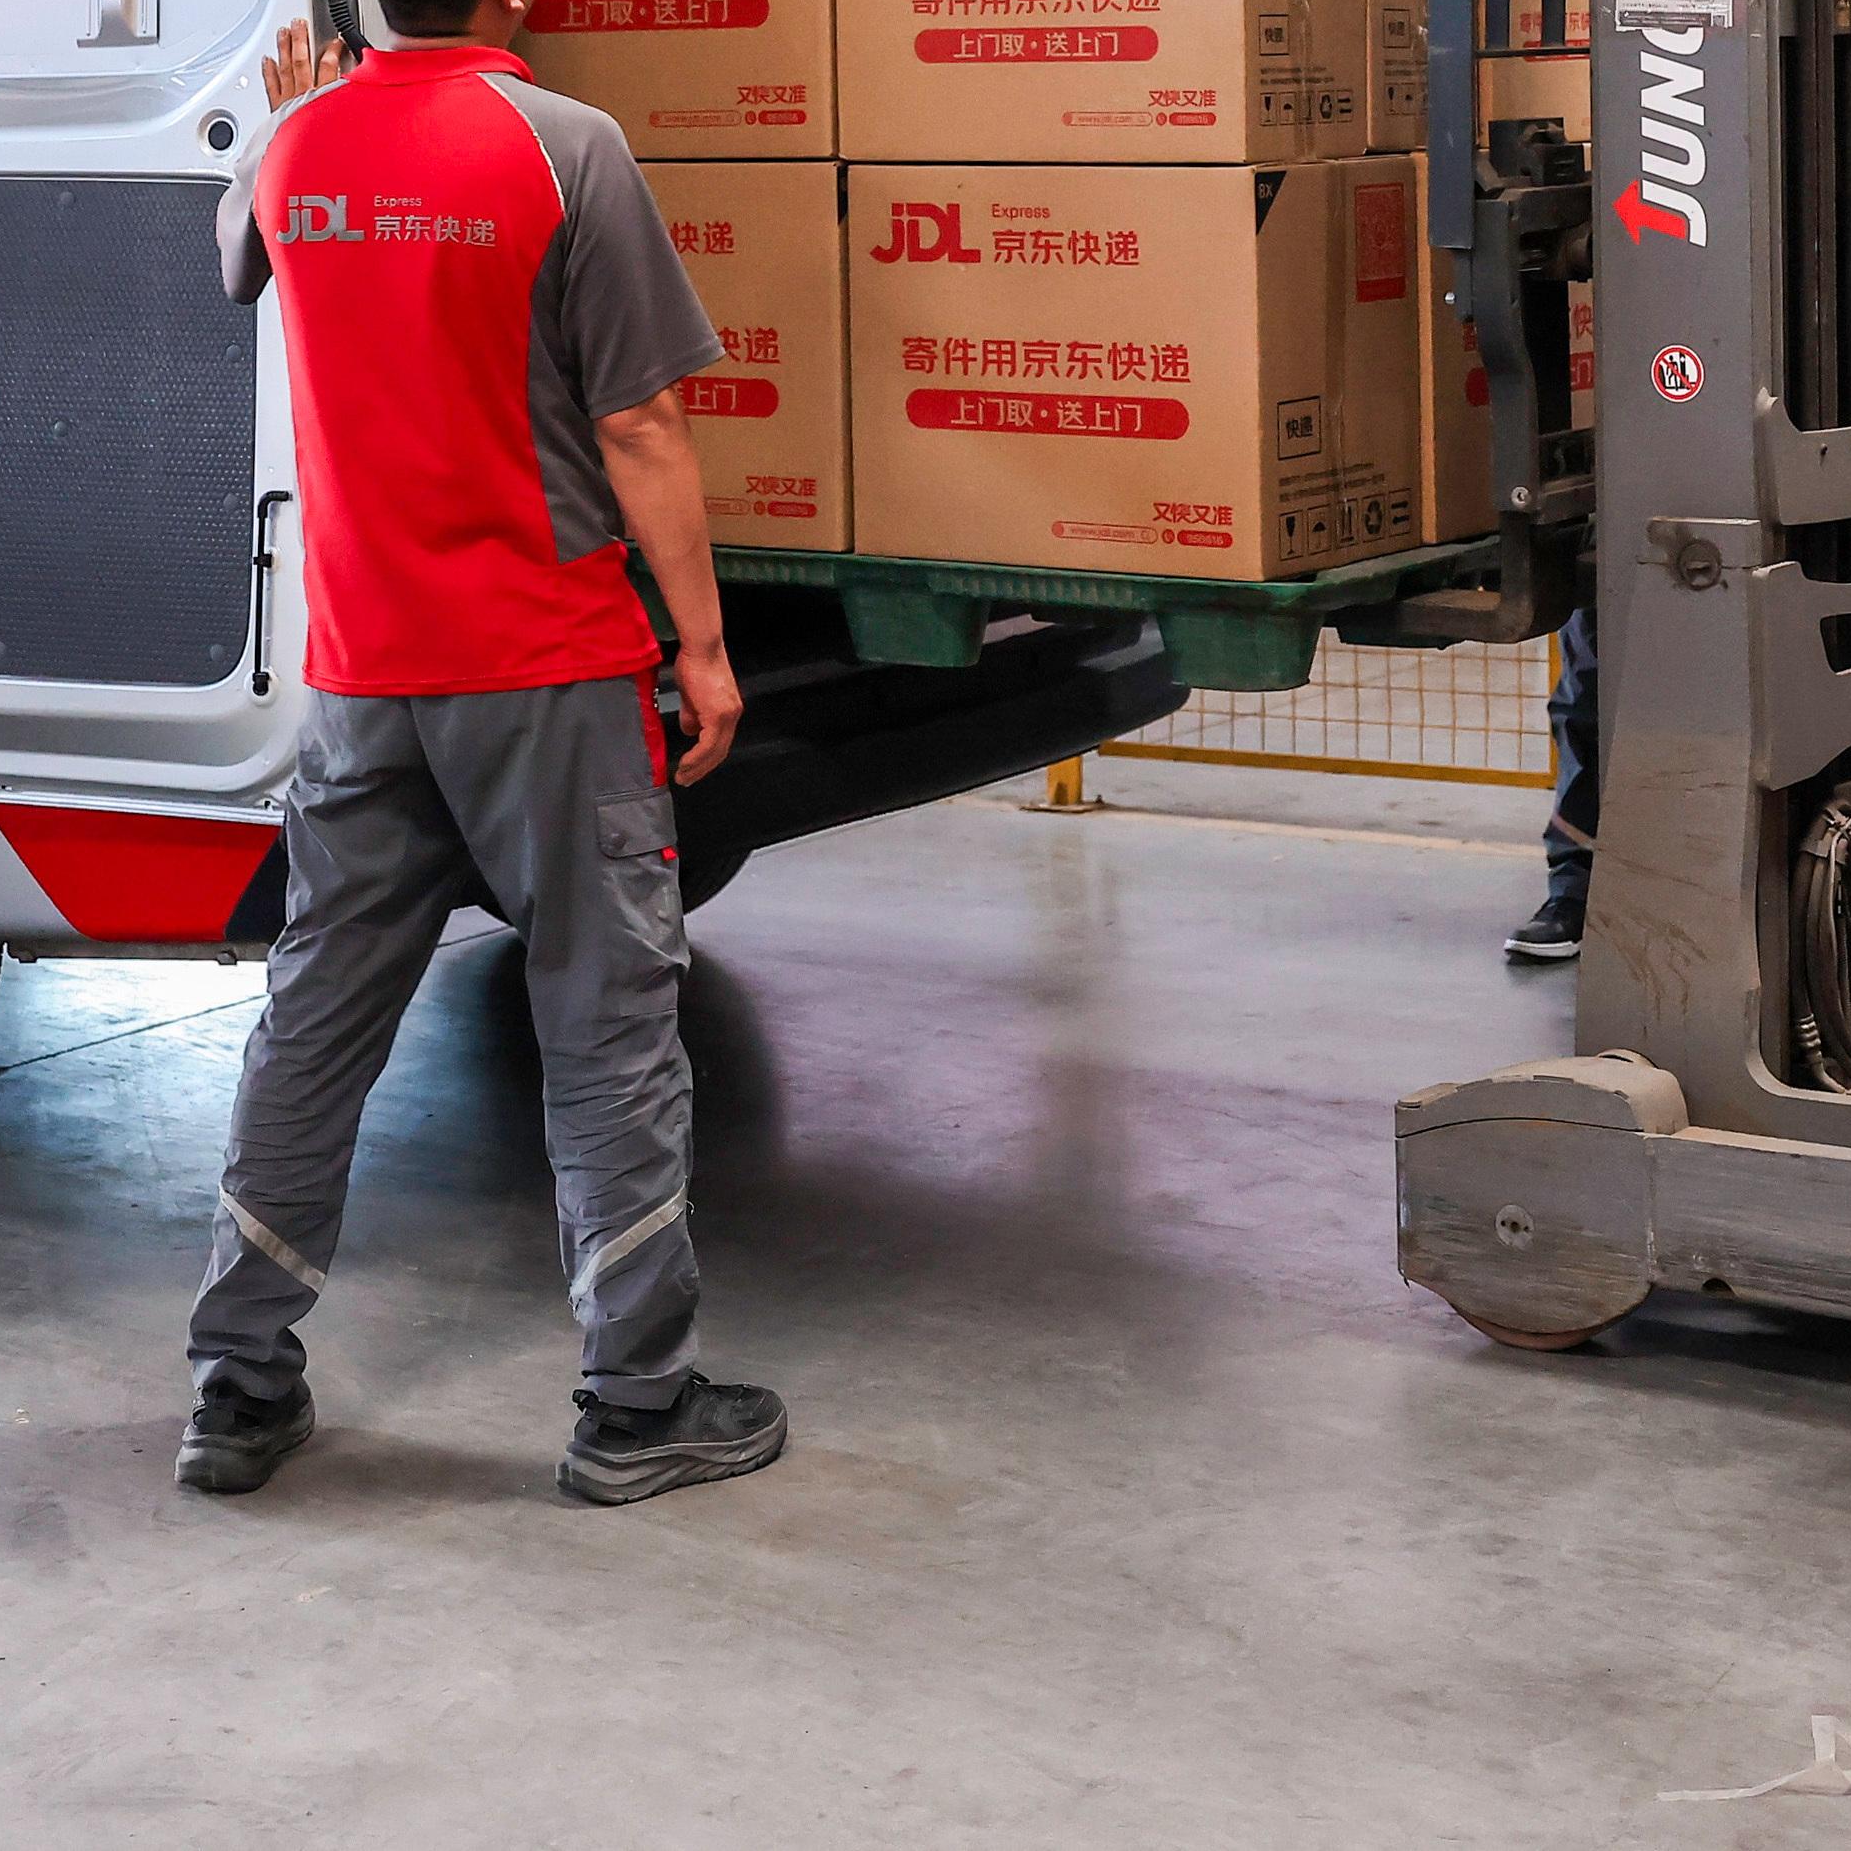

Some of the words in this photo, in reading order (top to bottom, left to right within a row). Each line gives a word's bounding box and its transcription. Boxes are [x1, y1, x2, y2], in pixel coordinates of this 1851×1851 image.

[952, 31, 1120, 60] 上门取·送上门
[373, 195, 423, 209] Express
[1258, 182, 1274, 199] 8X
[275, 195, 366, 245] JDL
[990, 203, 1051, 220] Express
[374, 214, 497, 248] 京东快递
[868, 202, 982, 264] JDL
[992, 228, 1141, 267] 京东快递
[901, 336, 1192, 384] 寄件用京东快递
[674, 382, 737, 413] 上门
[949, 395, 1144, 433] 上门取·送上门
[1152, 502, 1234, 527] 又快又准
